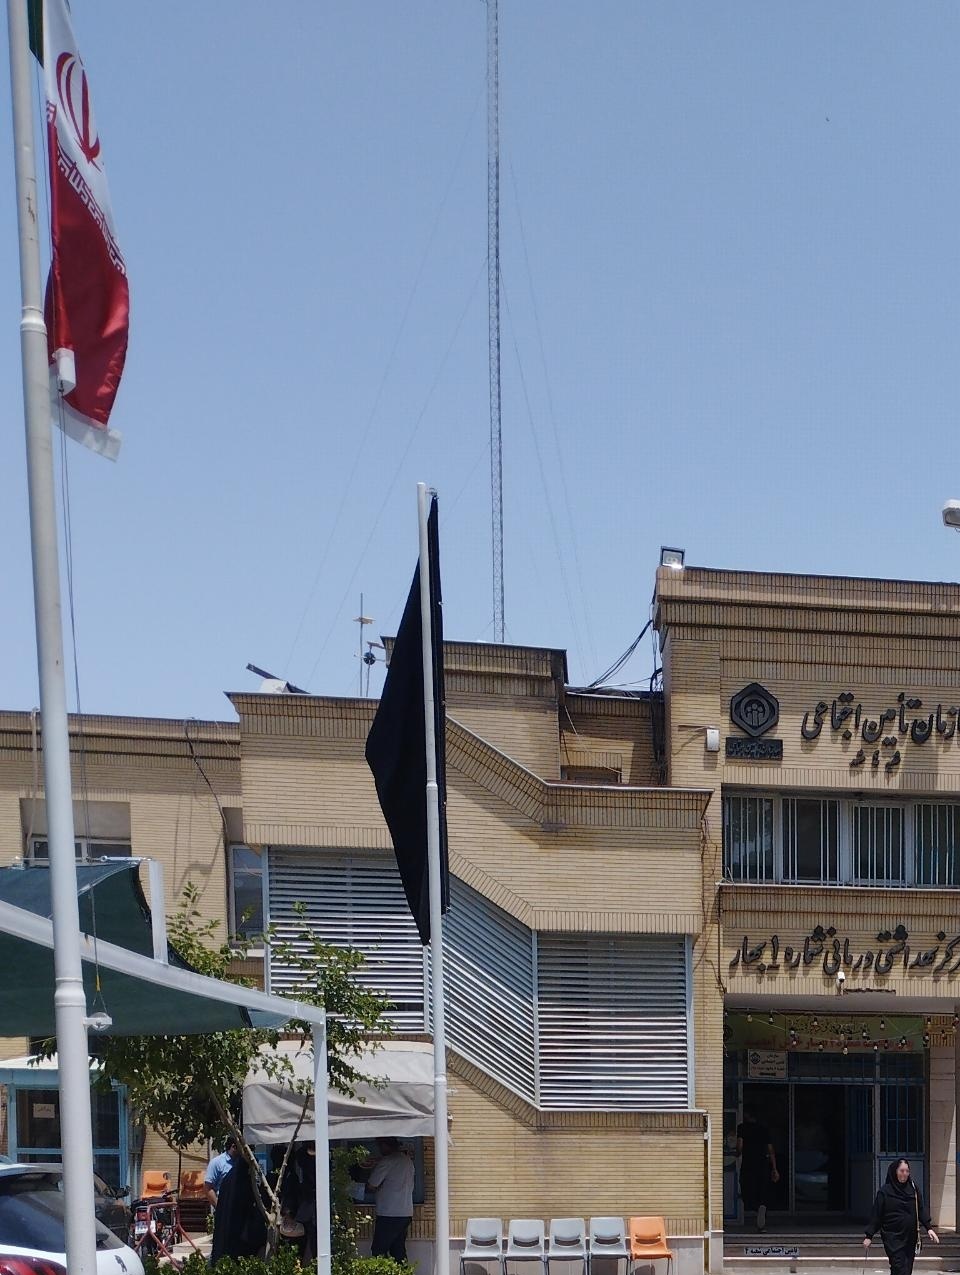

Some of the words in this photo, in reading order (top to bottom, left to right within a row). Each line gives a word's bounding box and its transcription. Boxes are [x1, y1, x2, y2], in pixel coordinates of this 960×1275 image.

[801, 692, 862, 740] اجتماعی
[785, 925, 826, 968] شماره
[823, 926, 873, 975] درمانی
